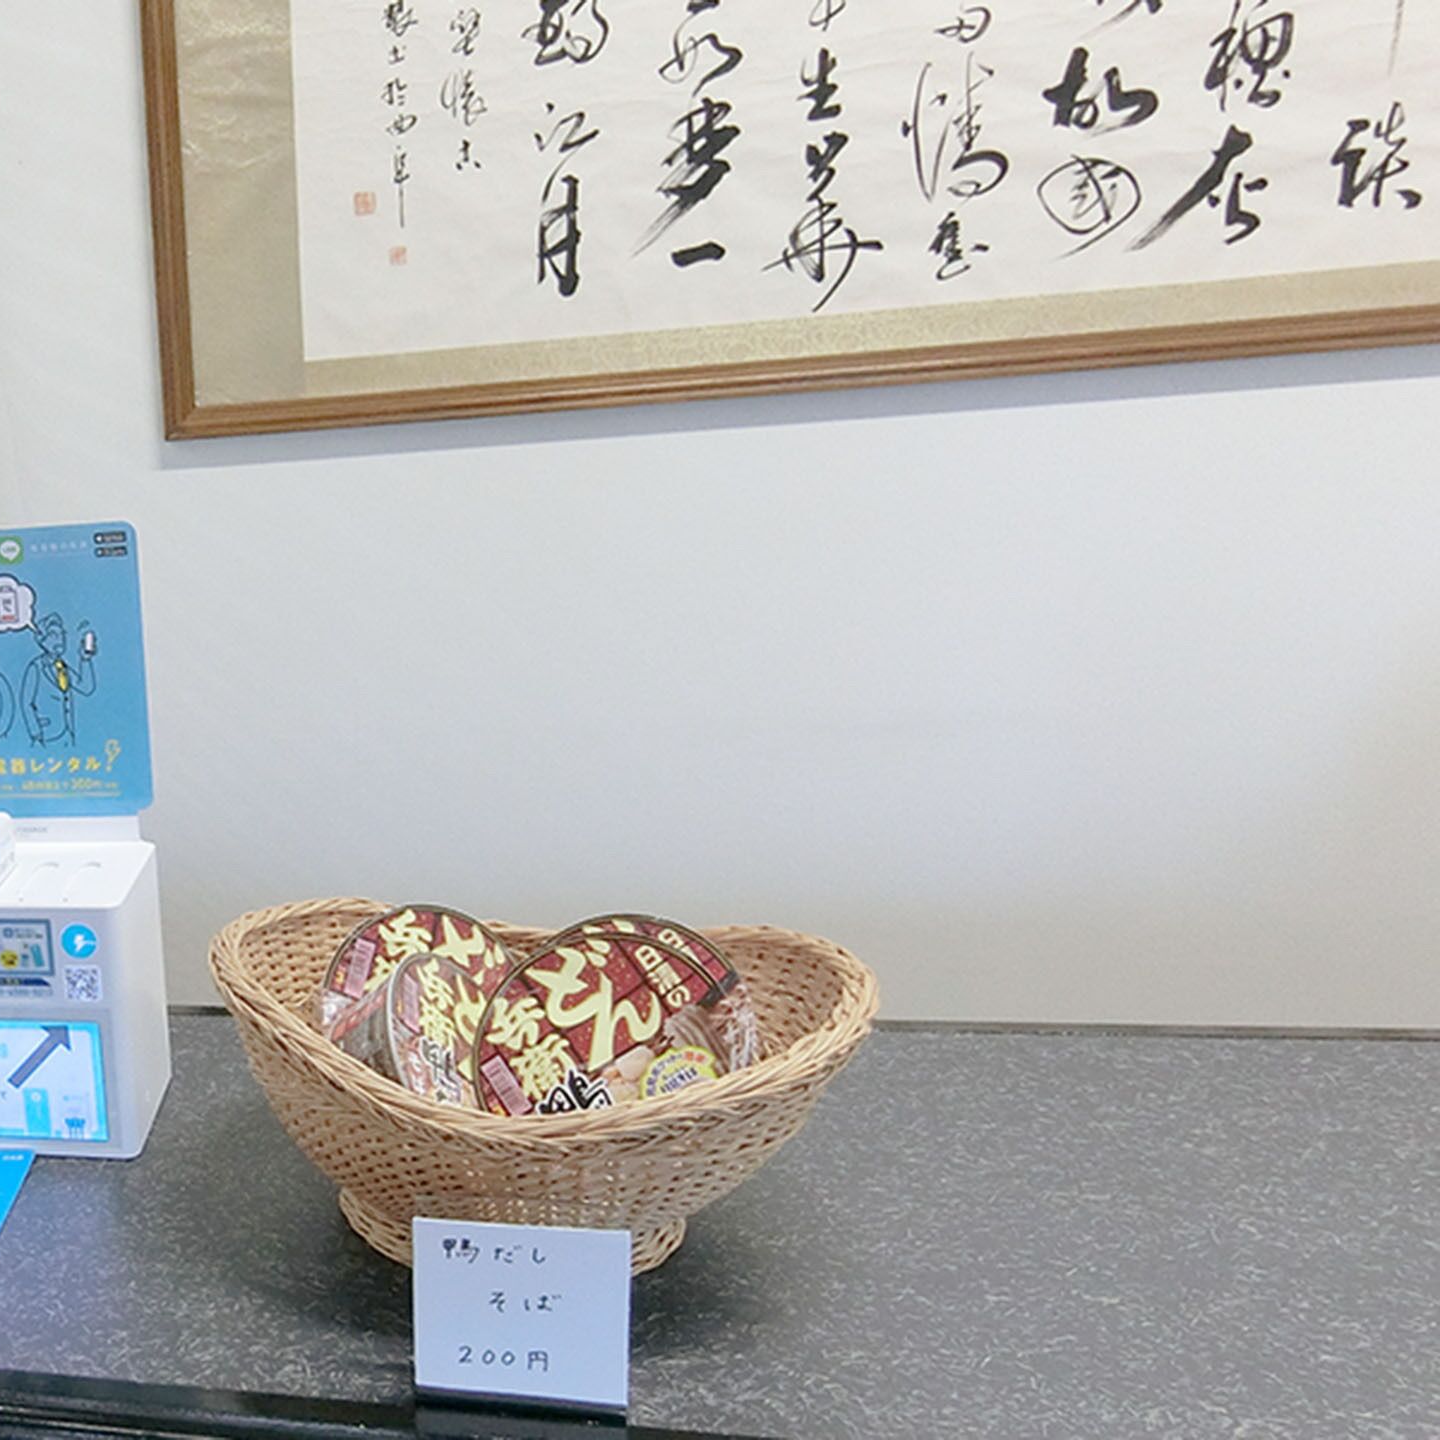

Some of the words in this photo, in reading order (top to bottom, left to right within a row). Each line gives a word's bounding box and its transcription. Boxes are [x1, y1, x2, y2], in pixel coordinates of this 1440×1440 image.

[442, 1237, 547, 1264] 鴨だし
[489, 1291, 562, 1313] そば
[458, 1345, 549, 1372] 200円
